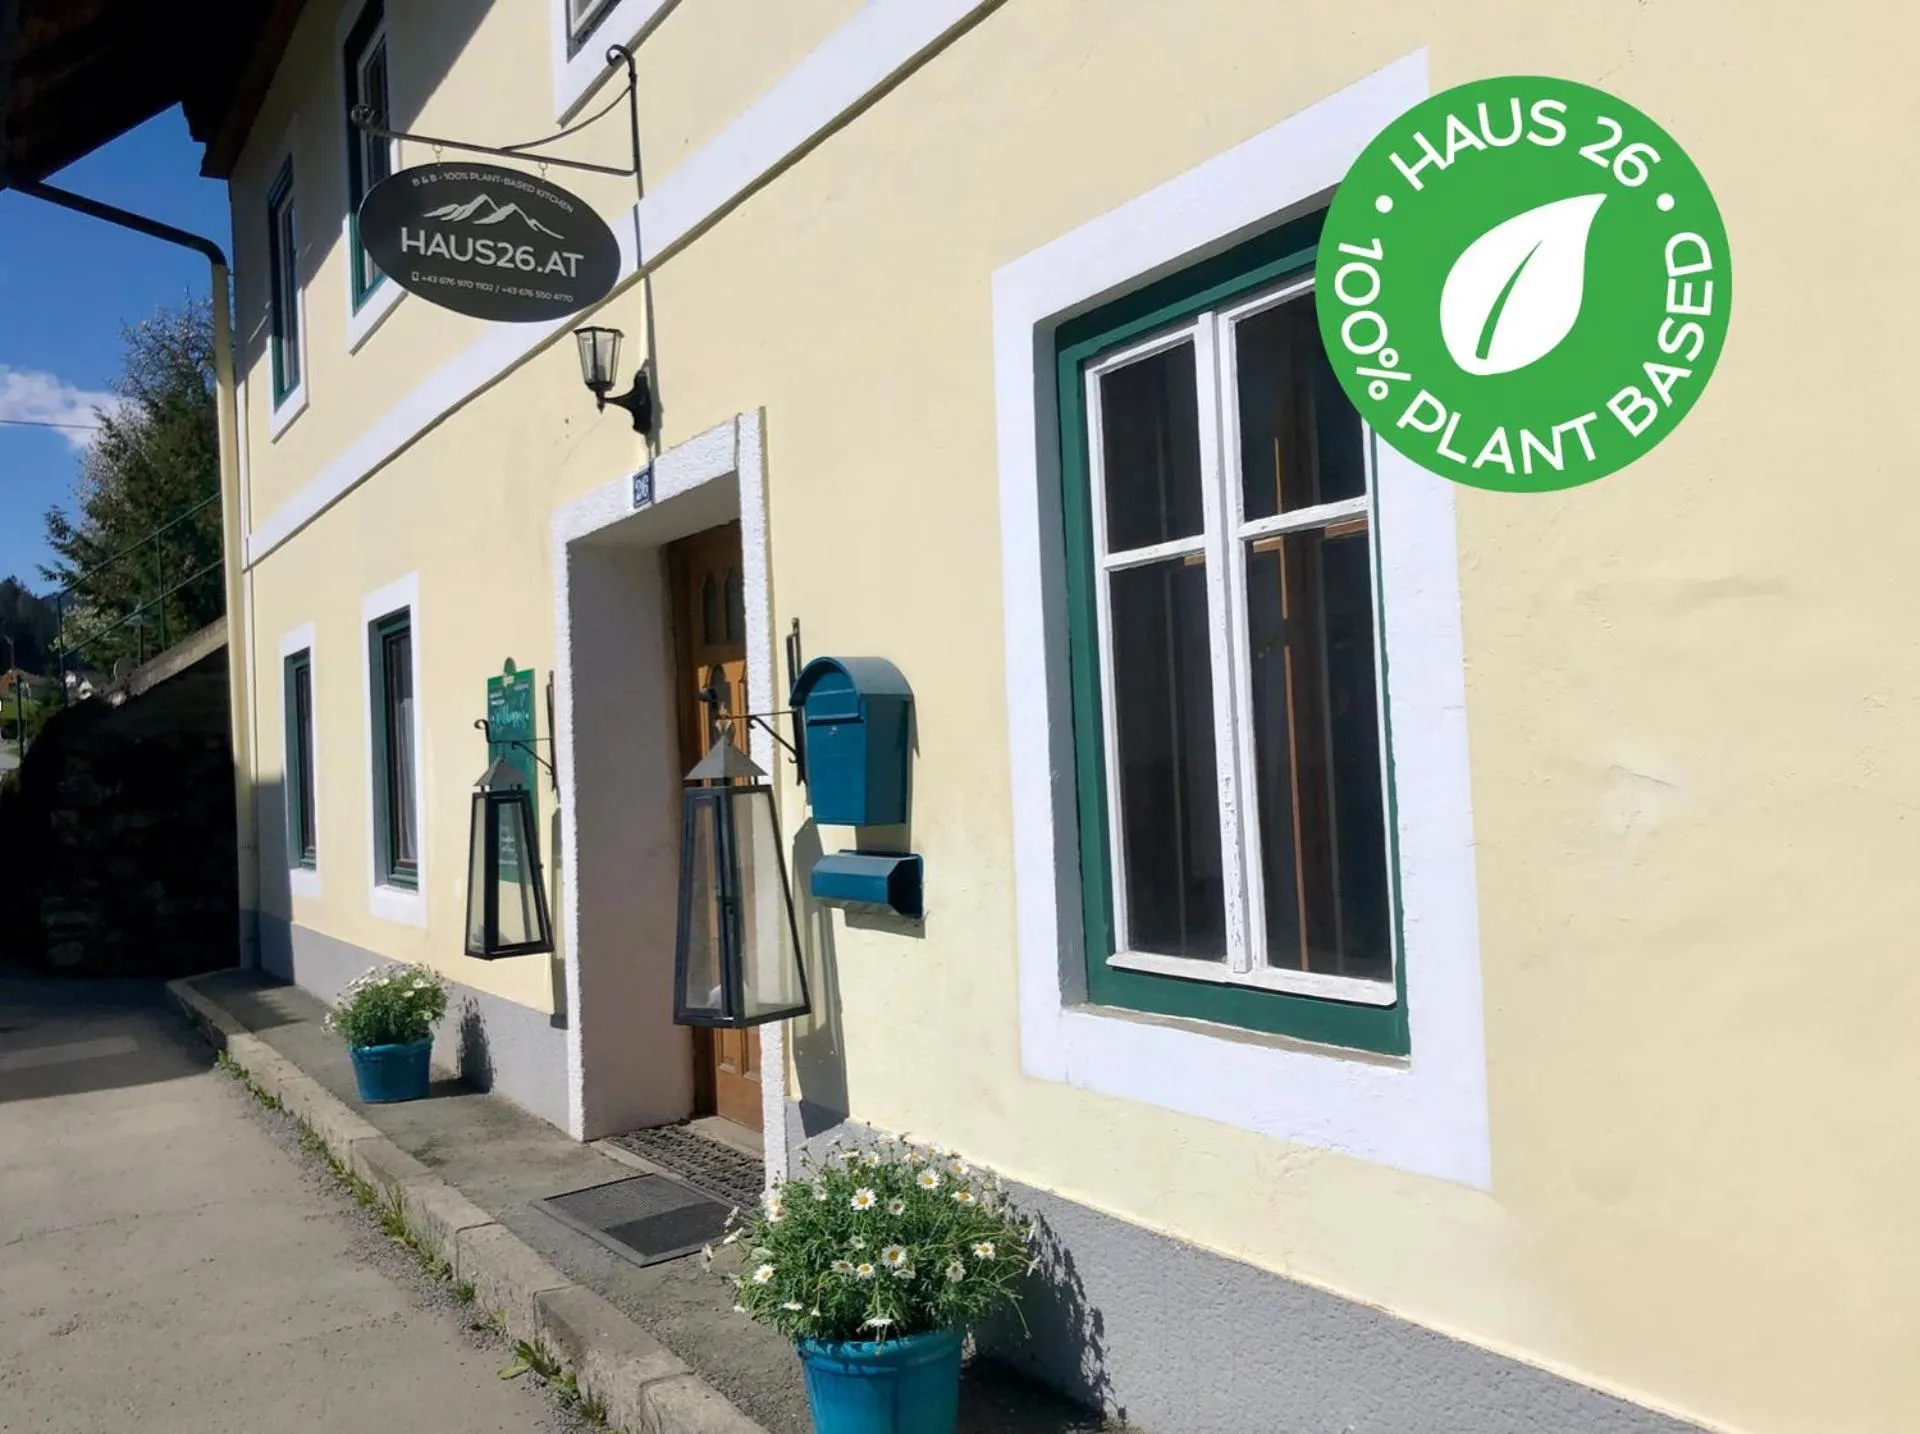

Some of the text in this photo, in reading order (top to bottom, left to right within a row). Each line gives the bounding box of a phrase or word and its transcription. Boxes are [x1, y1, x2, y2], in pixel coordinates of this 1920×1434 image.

[412, 177, 420, 187] B
[470, 172, 536, 194] PLANT-BASED
[536, 188, 574, 213] KITCHEN
[401, 227, 584, 278] HAUS26.AT
[422, 275, 438, 284] +43
[439, 277, 456, 286] 676
[457, 279, 474, 288] 970
[501, 287, 517, 295] +43
[553, 293, 574, 303] 4770
